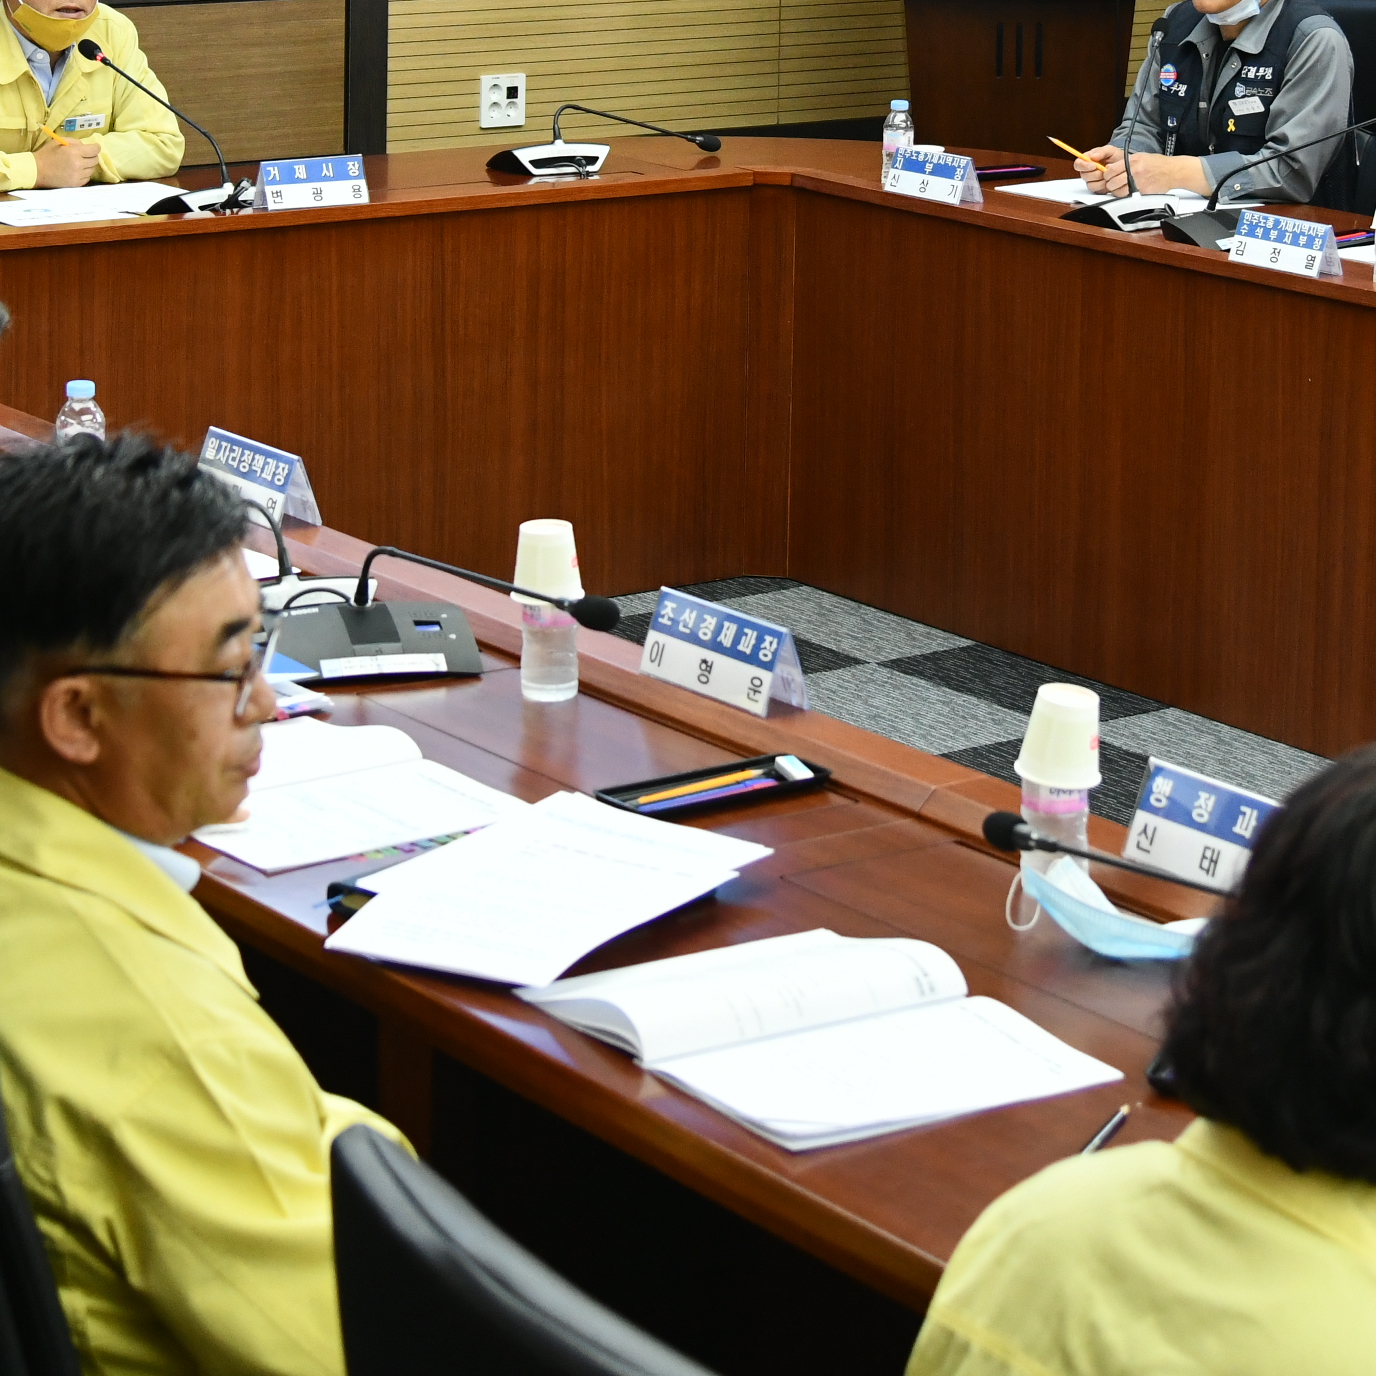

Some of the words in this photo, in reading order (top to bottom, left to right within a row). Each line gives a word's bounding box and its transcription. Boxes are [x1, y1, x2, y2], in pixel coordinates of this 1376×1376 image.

[1243, 211, 1276, 229] 민주노총
[205, 436, 289, 486] 일자리정책과장
[657, 599, 779, 663] 조선경제과장
